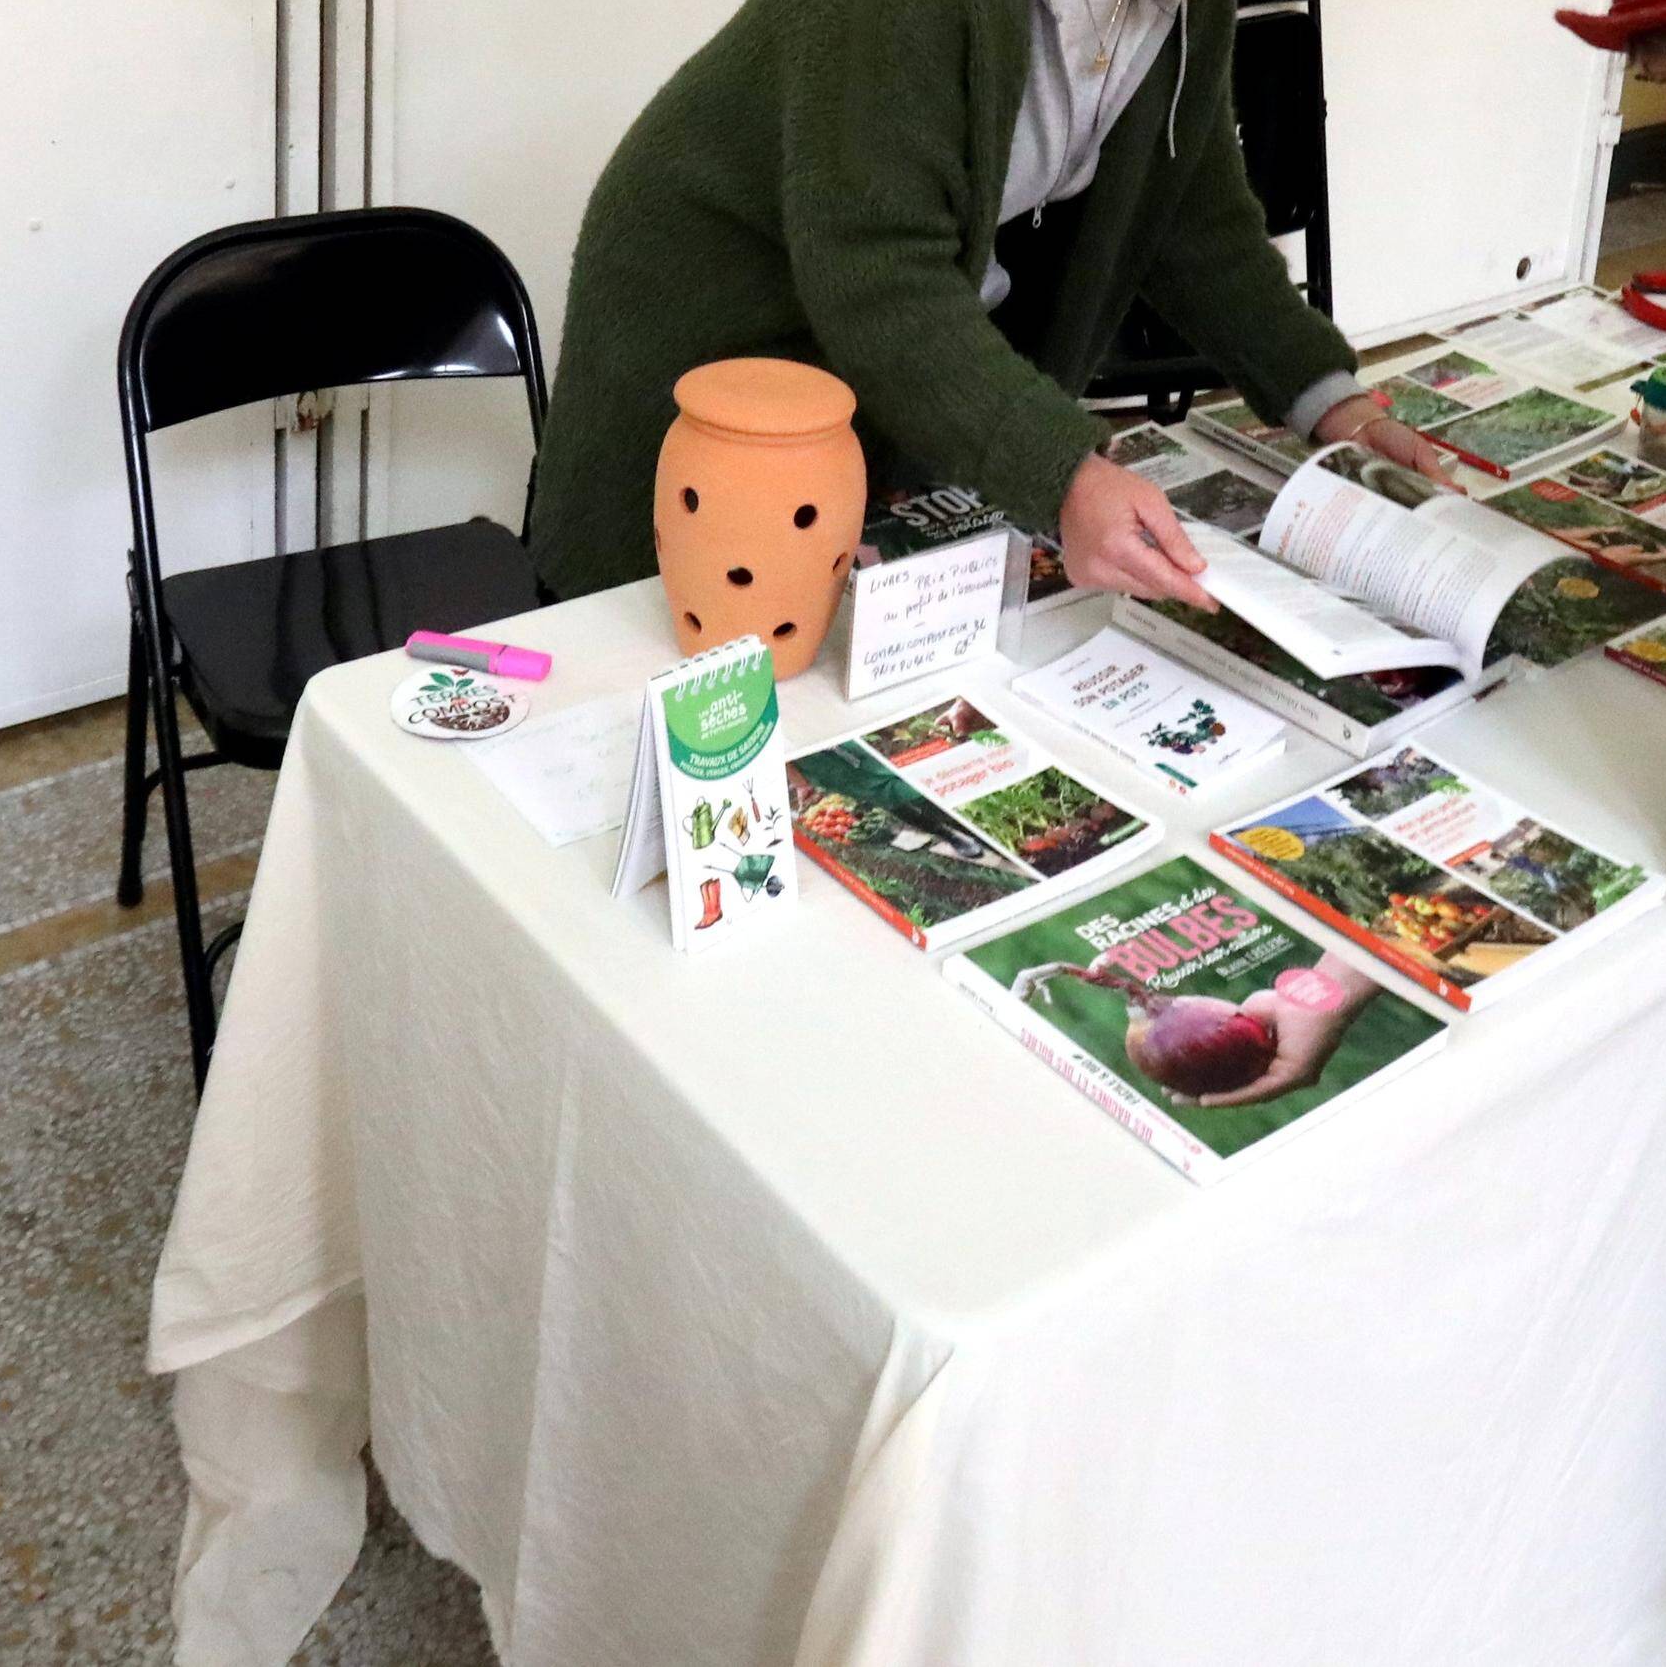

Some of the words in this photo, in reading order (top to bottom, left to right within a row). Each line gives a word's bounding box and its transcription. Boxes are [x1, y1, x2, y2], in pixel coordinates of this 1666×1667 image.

[869, 570, 910, 595] LIVRES
[905, 595, 934, 619] profit
[871, 662, 897, 680] PRIX
[899, 651, 935, 672] PUBLIC
[411, 684, 498, 706] TERRES
[1119, 680, 1150, 702] POTS
[407, 694, 515, 725] COMPOST
[1074, 912, 1121, 941] DES
[1089, 901, 1183, 953] RACINES
[1106, 894, 1259, 985] BULBES
